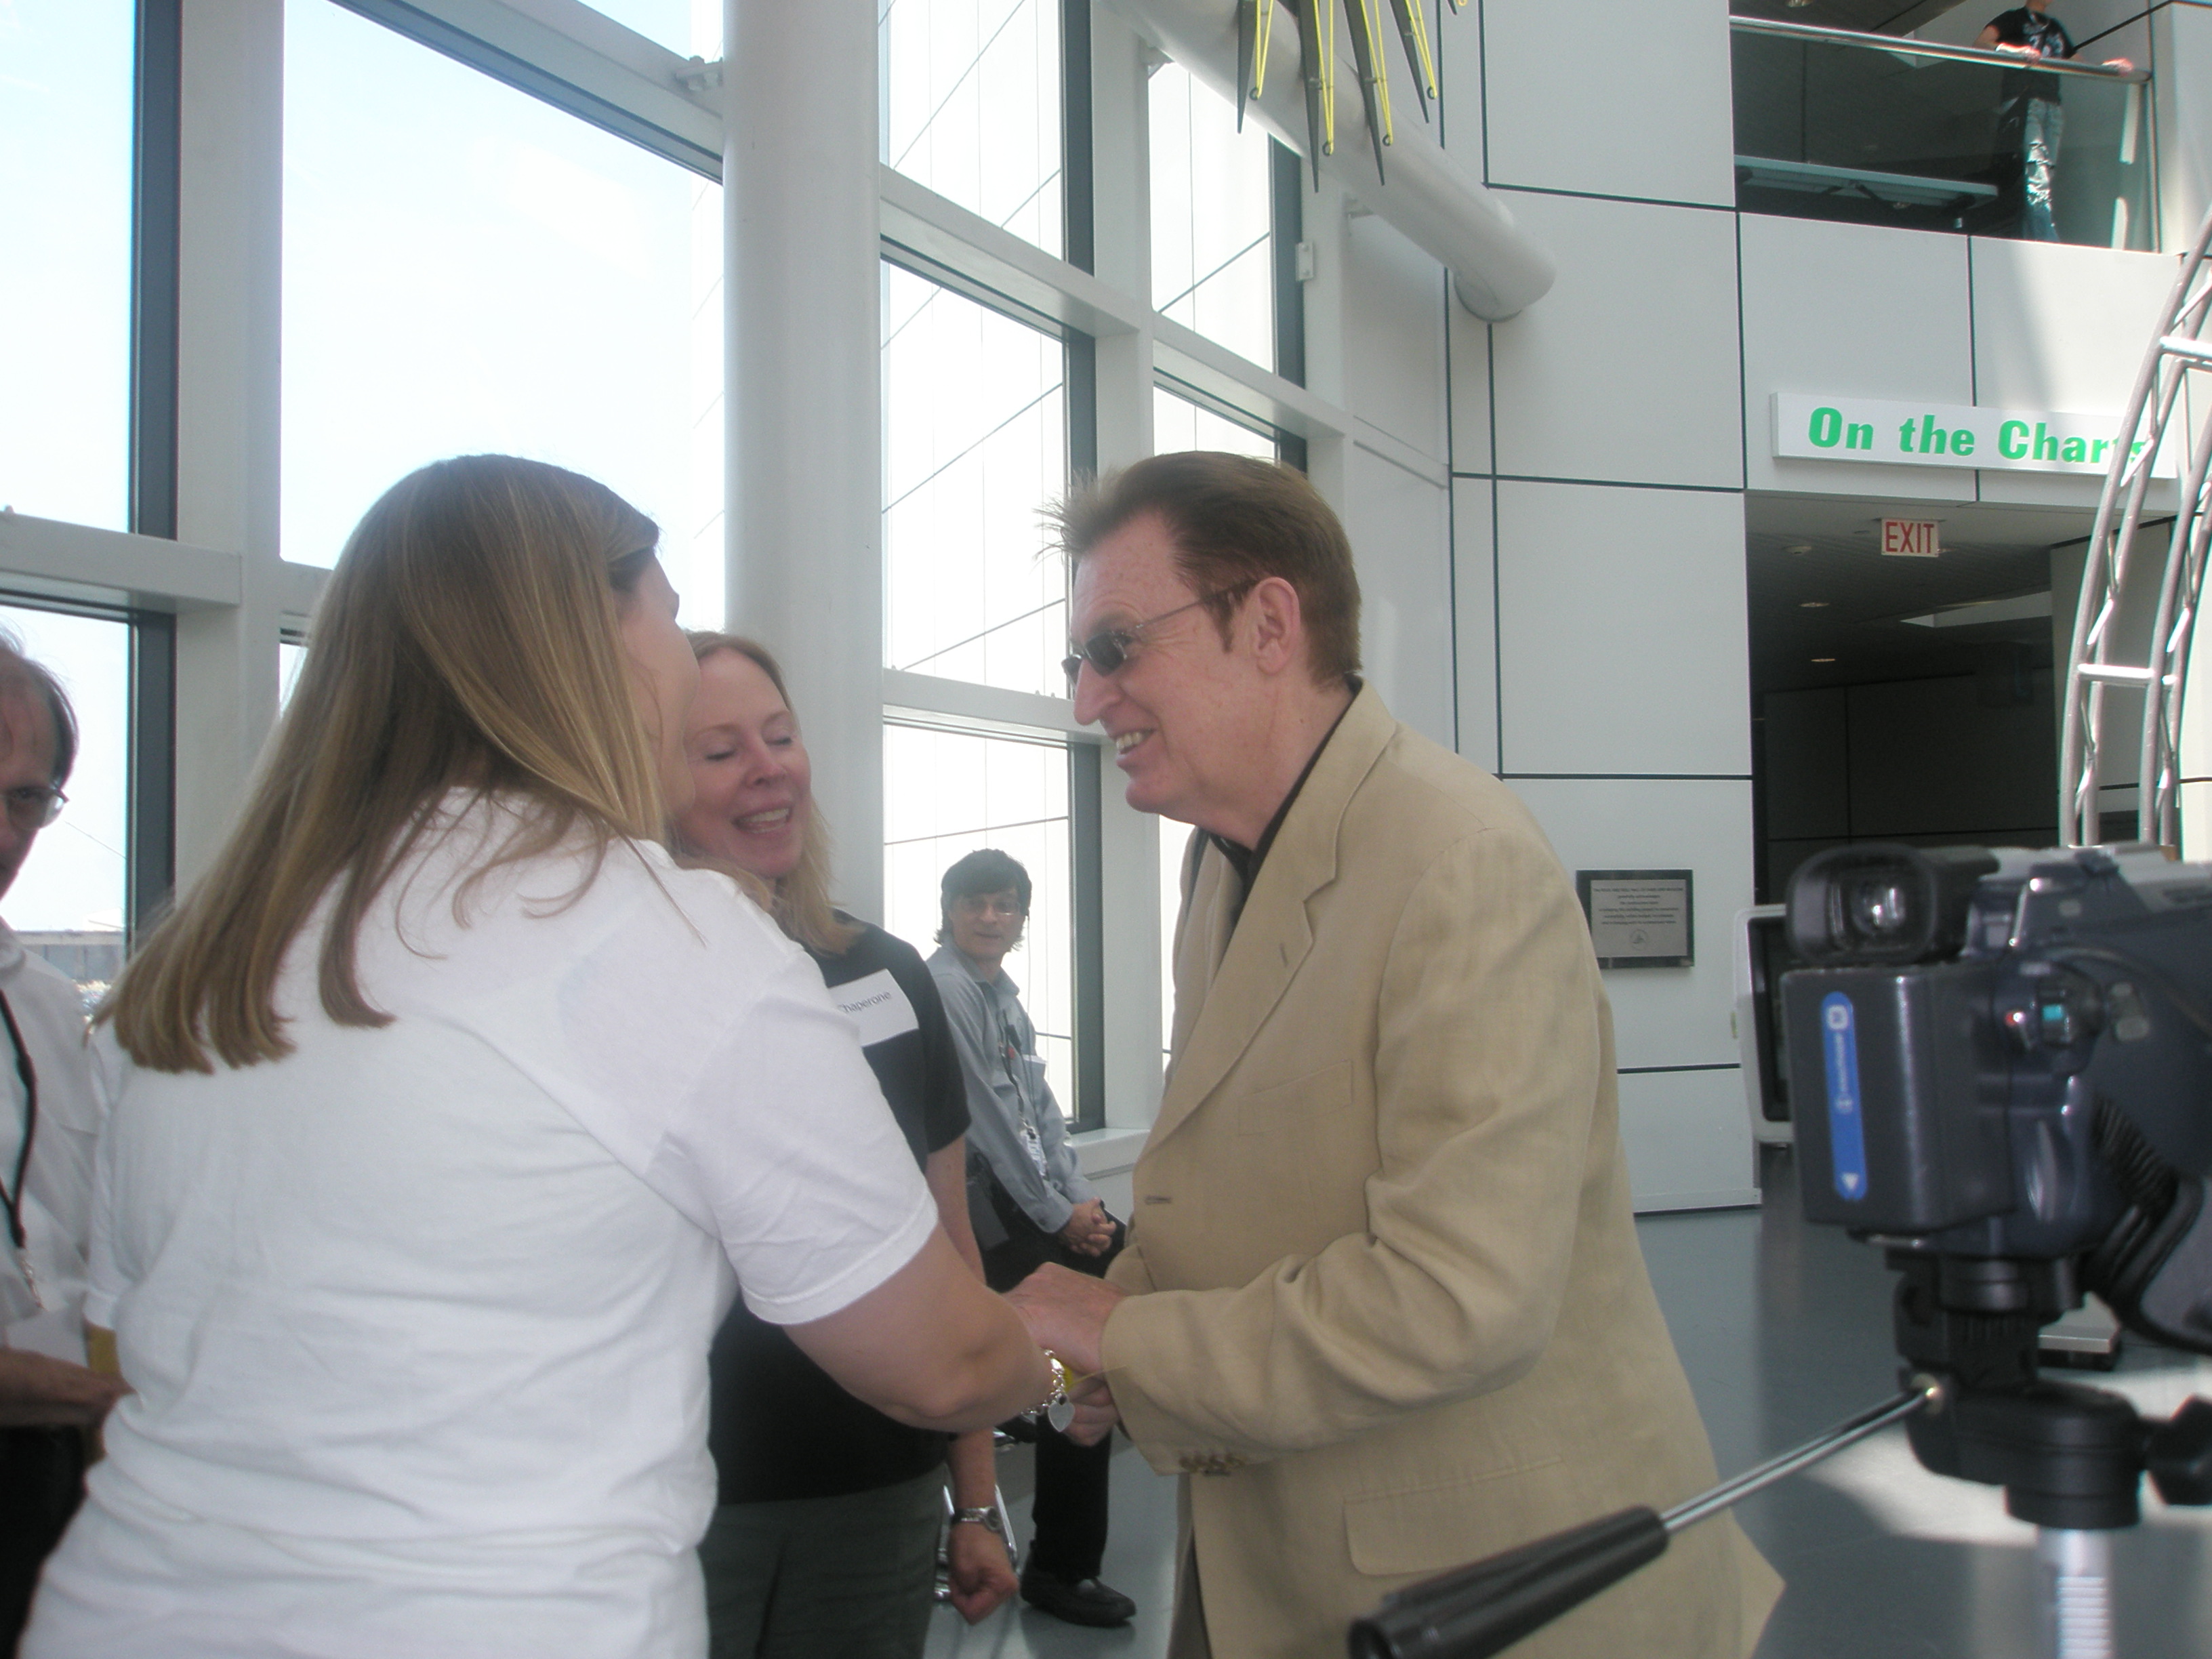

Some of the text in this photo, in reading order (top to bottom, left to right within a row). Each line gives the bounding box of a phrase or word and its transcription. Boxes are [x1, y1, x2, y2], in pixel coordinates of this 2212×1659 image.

[1808, 407, 2147, 464] On the Char
[1885, 521, 1934, 554] EXIT
